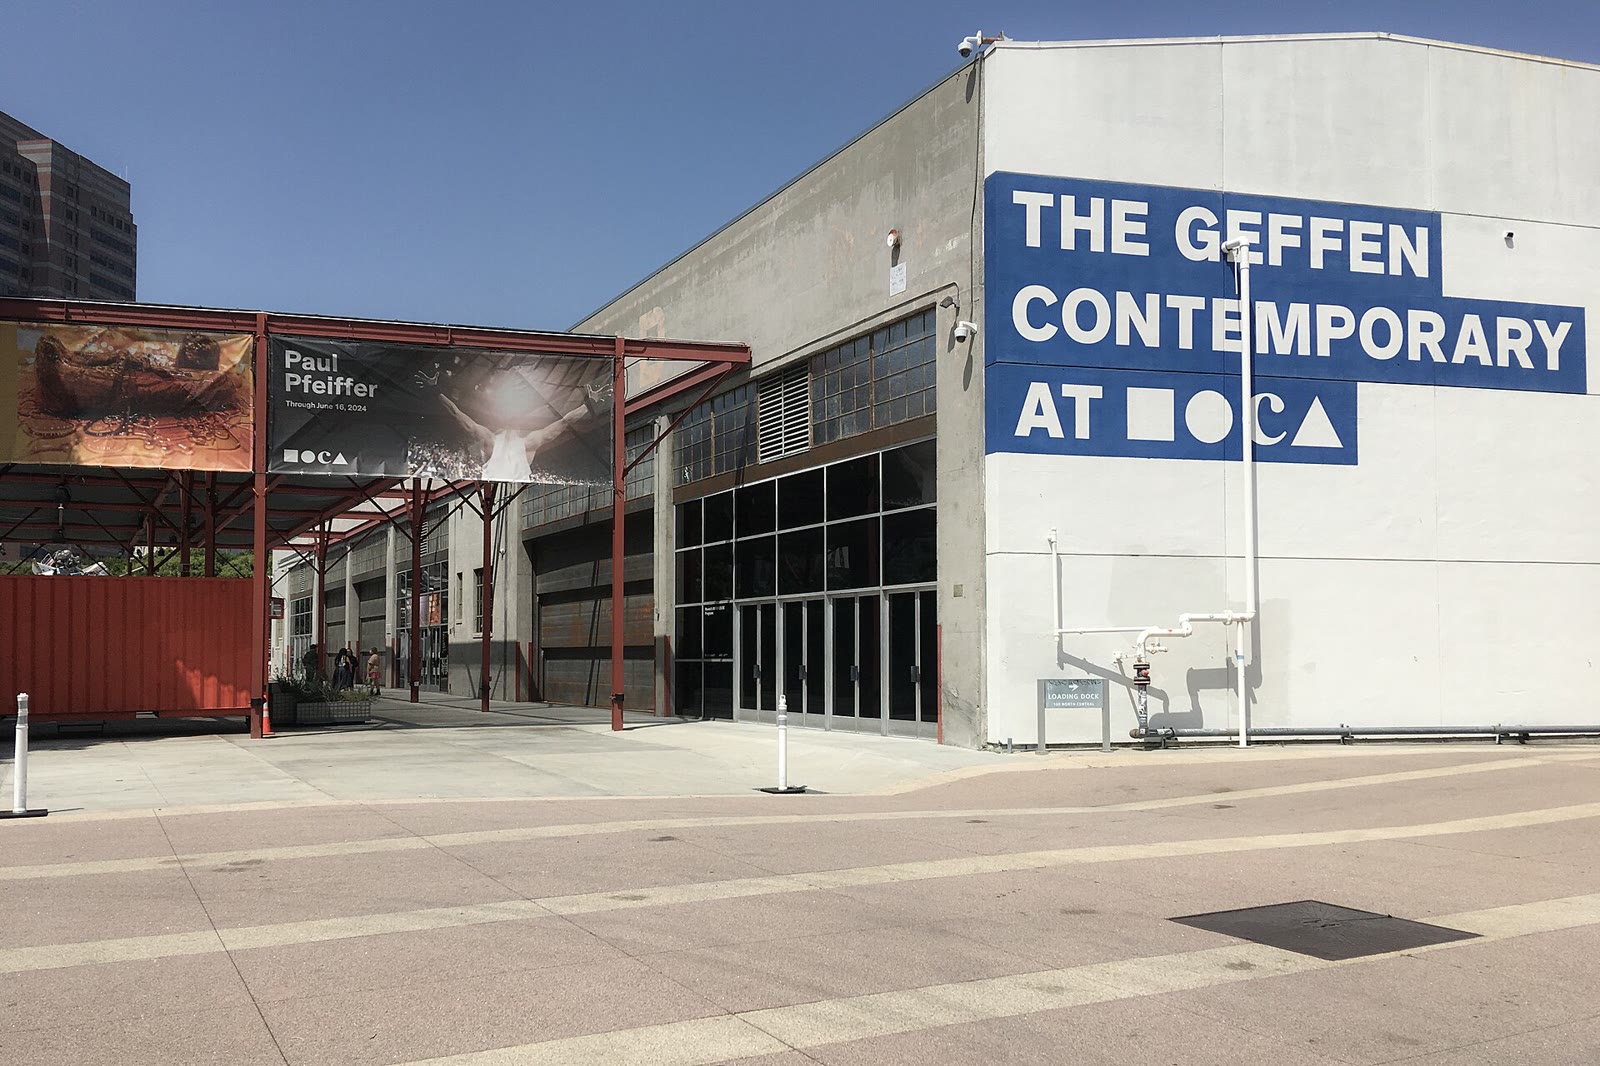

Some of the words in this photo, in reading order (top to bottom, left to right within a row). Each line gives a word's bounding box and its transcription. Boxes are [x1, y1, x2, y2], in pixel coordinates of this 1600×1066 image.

[1012, 190, 1150, 257] THE
[1174, 206, 1429, 279] GEFFEN
[1011, 284, 1573, 371] CONTEMPORARY
[285, 350, 339, 372] Paul
[285, 373, 378, 398] Pfeiffer
[286, 400, 316, 410] Through
[316, 402, 333, 410] June
[335, 403, 347, 412] 16,
[348, 404, 367, 412] 2024
[1014, 381, 1104, 440] AT
